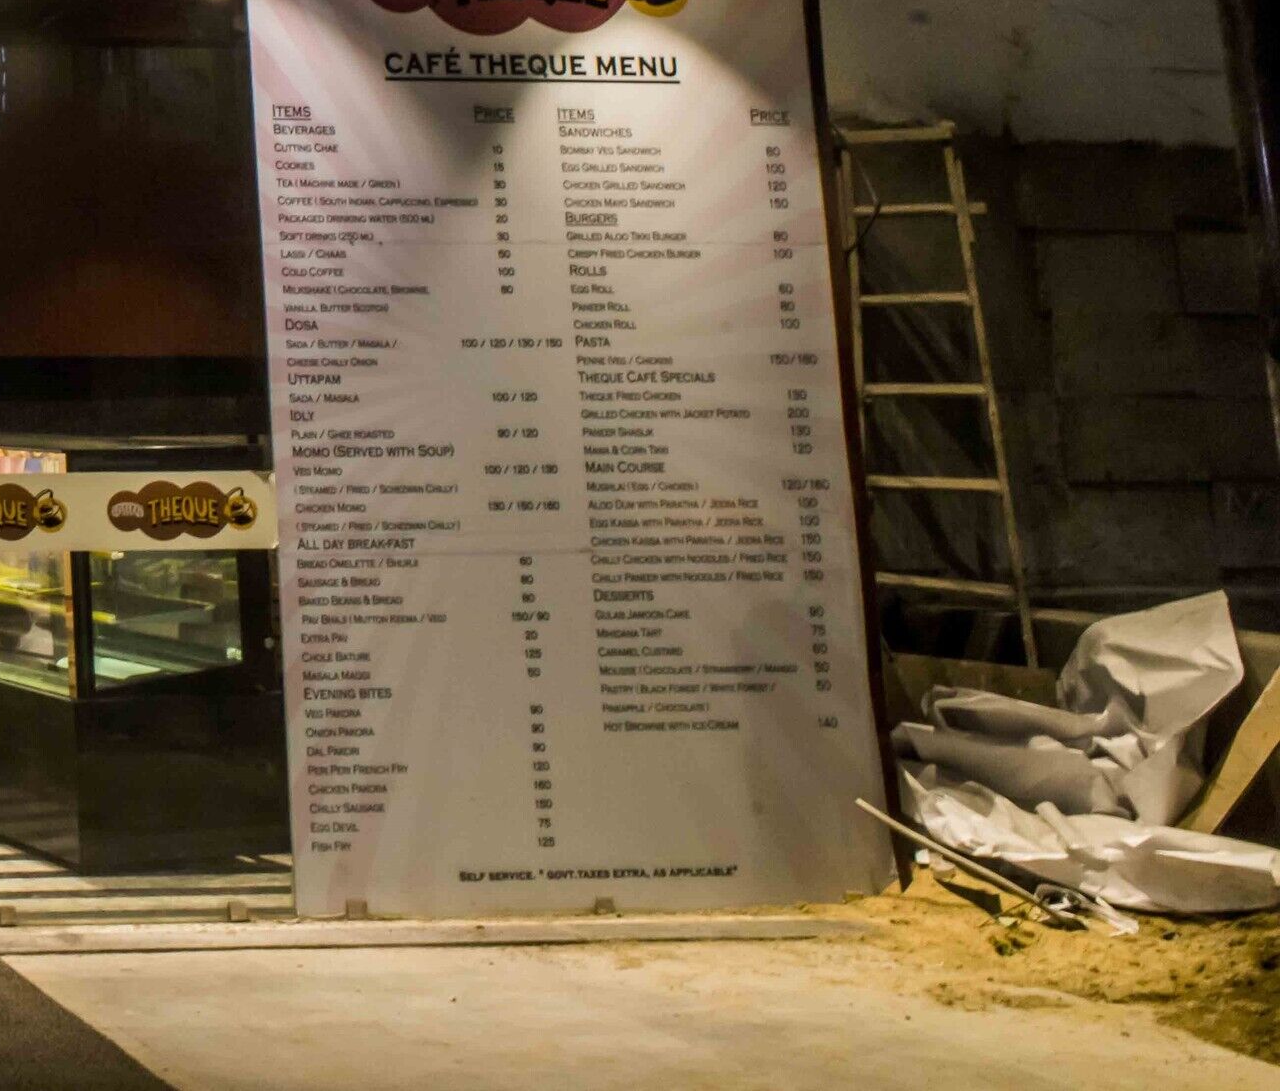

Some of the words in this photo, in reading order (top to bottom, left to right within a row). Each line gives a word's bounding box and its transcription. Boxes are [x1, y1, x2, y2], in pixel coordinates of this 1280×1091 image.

[384, 47, 460, 75] CAFÉ
[469, 53, 587, 79] THEQUE
[596, 55, 678, 78] MENU
[272, 104, 312, 119] ITEMS
[557, 108, 596, 122] ITEMS
[750, 109, 791, 124] PRICE
[273, 124, 336, 135] BEVERAGES
[559, 126, 633, 137] SANDWICHES
[274, 143, 312, 153] CUTTING
[616, 146, 662, 156] SANDWICH
[582, 163, 617, 173] GRILLED
[619, 163, 665, 173] SANDWICH
[765, 163, 786, 174] 100
[276, 178, 293, 188] TEA
[603, 181, 638, 190] GRILLED
[640, 181, 686, 190] SANDWICH
[768, 181, 788, 192] 120
[278, 196, 313, 206] COFFEE
[629, 198, 675, 208] SANDWICH
[278, 214, 325, 223] PACKAGED
[368, 214, 397, 223] WATER
[565, 212, 618, 225] BURGERS
[309, 267, 345, 277] COFFEE
[569, 265, 608, 277] ROLLS
[285, 319, 319, 331] DOSA
[780, 318, 801, 330] 100
[575, 336, 611, 348] PASTA
[288, 374, 342, 386] UTTAPAM
[578, 371, 624, 384] THEQUE
[627, 370, 658, 384] CAFÉ
[661, 370, 717, 384] SPECIALS
[290, 410, 315, 421] IDLY
[292, 445, 330, 458] MOMO
[386, 445, 416, 457] WITH
[585, 461, 614, 473] MAIN
[617, 460, 666, 473] COURSE
[147, 496, 220, 528] THEQUE
[297, 539, 320, 550] ALL
[323, 539, 344, 550] DAY
[593, 589, 655, 602] DESSERTS
[304, 687, 357, 699] EVENING
[359, 687, 393, 699] BITES
[459, 870, 485, 882] SELF
